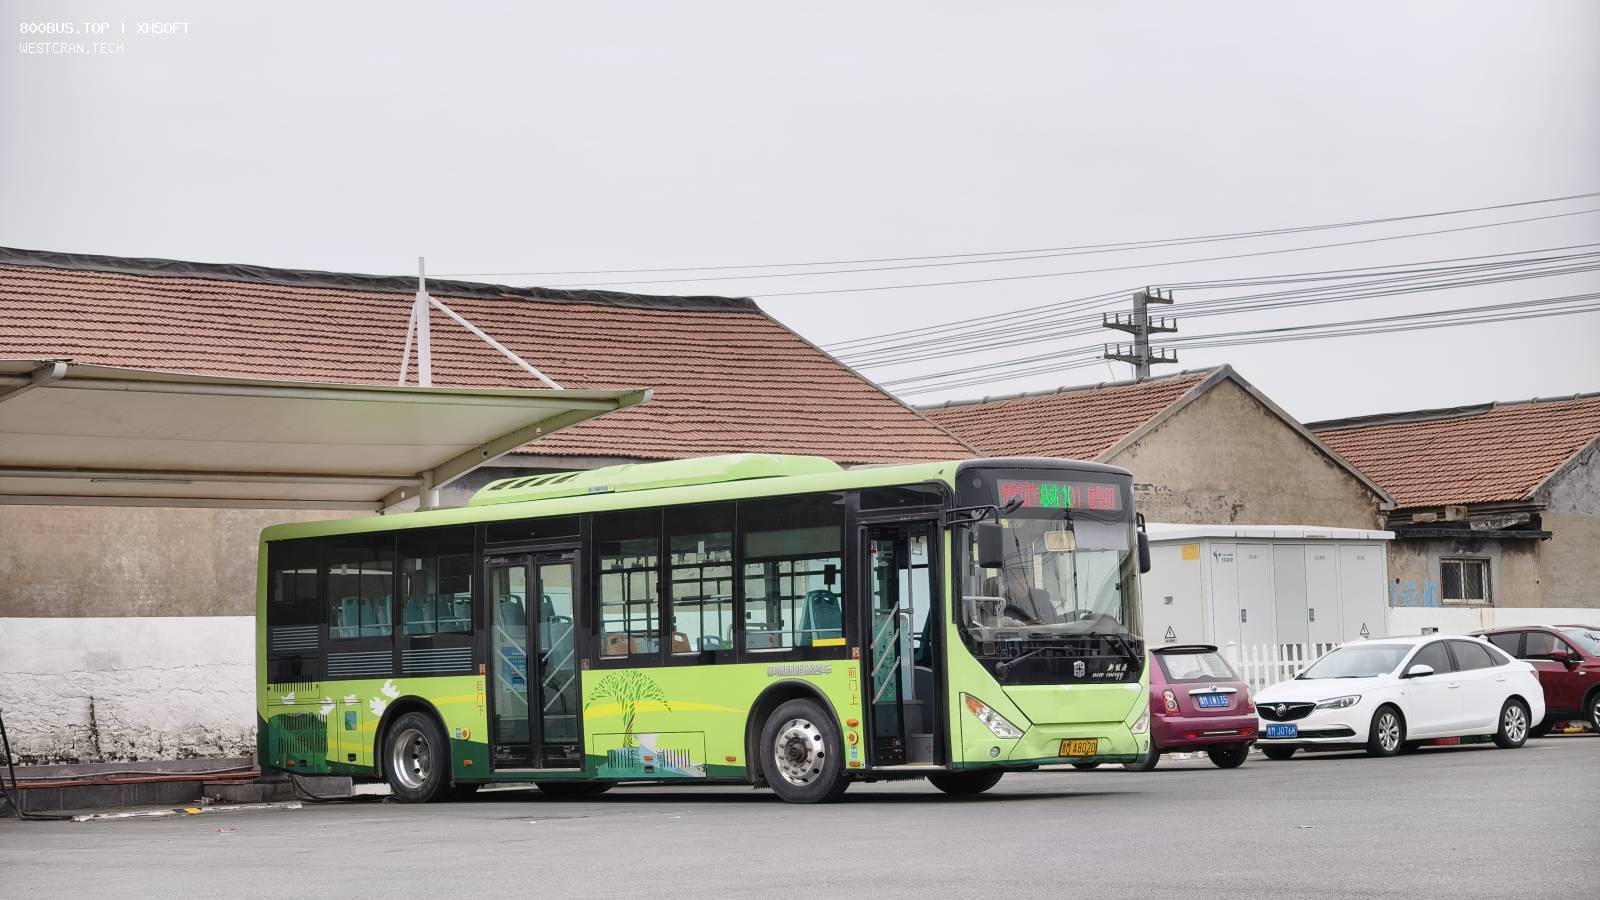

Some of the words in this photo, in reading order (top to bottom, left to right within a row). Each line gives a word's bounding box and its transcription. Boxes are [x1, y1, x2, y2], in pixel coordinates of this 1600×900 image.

[848, 666, 858, 706] 前门上
[1105, 672, 1124, 681] energy
